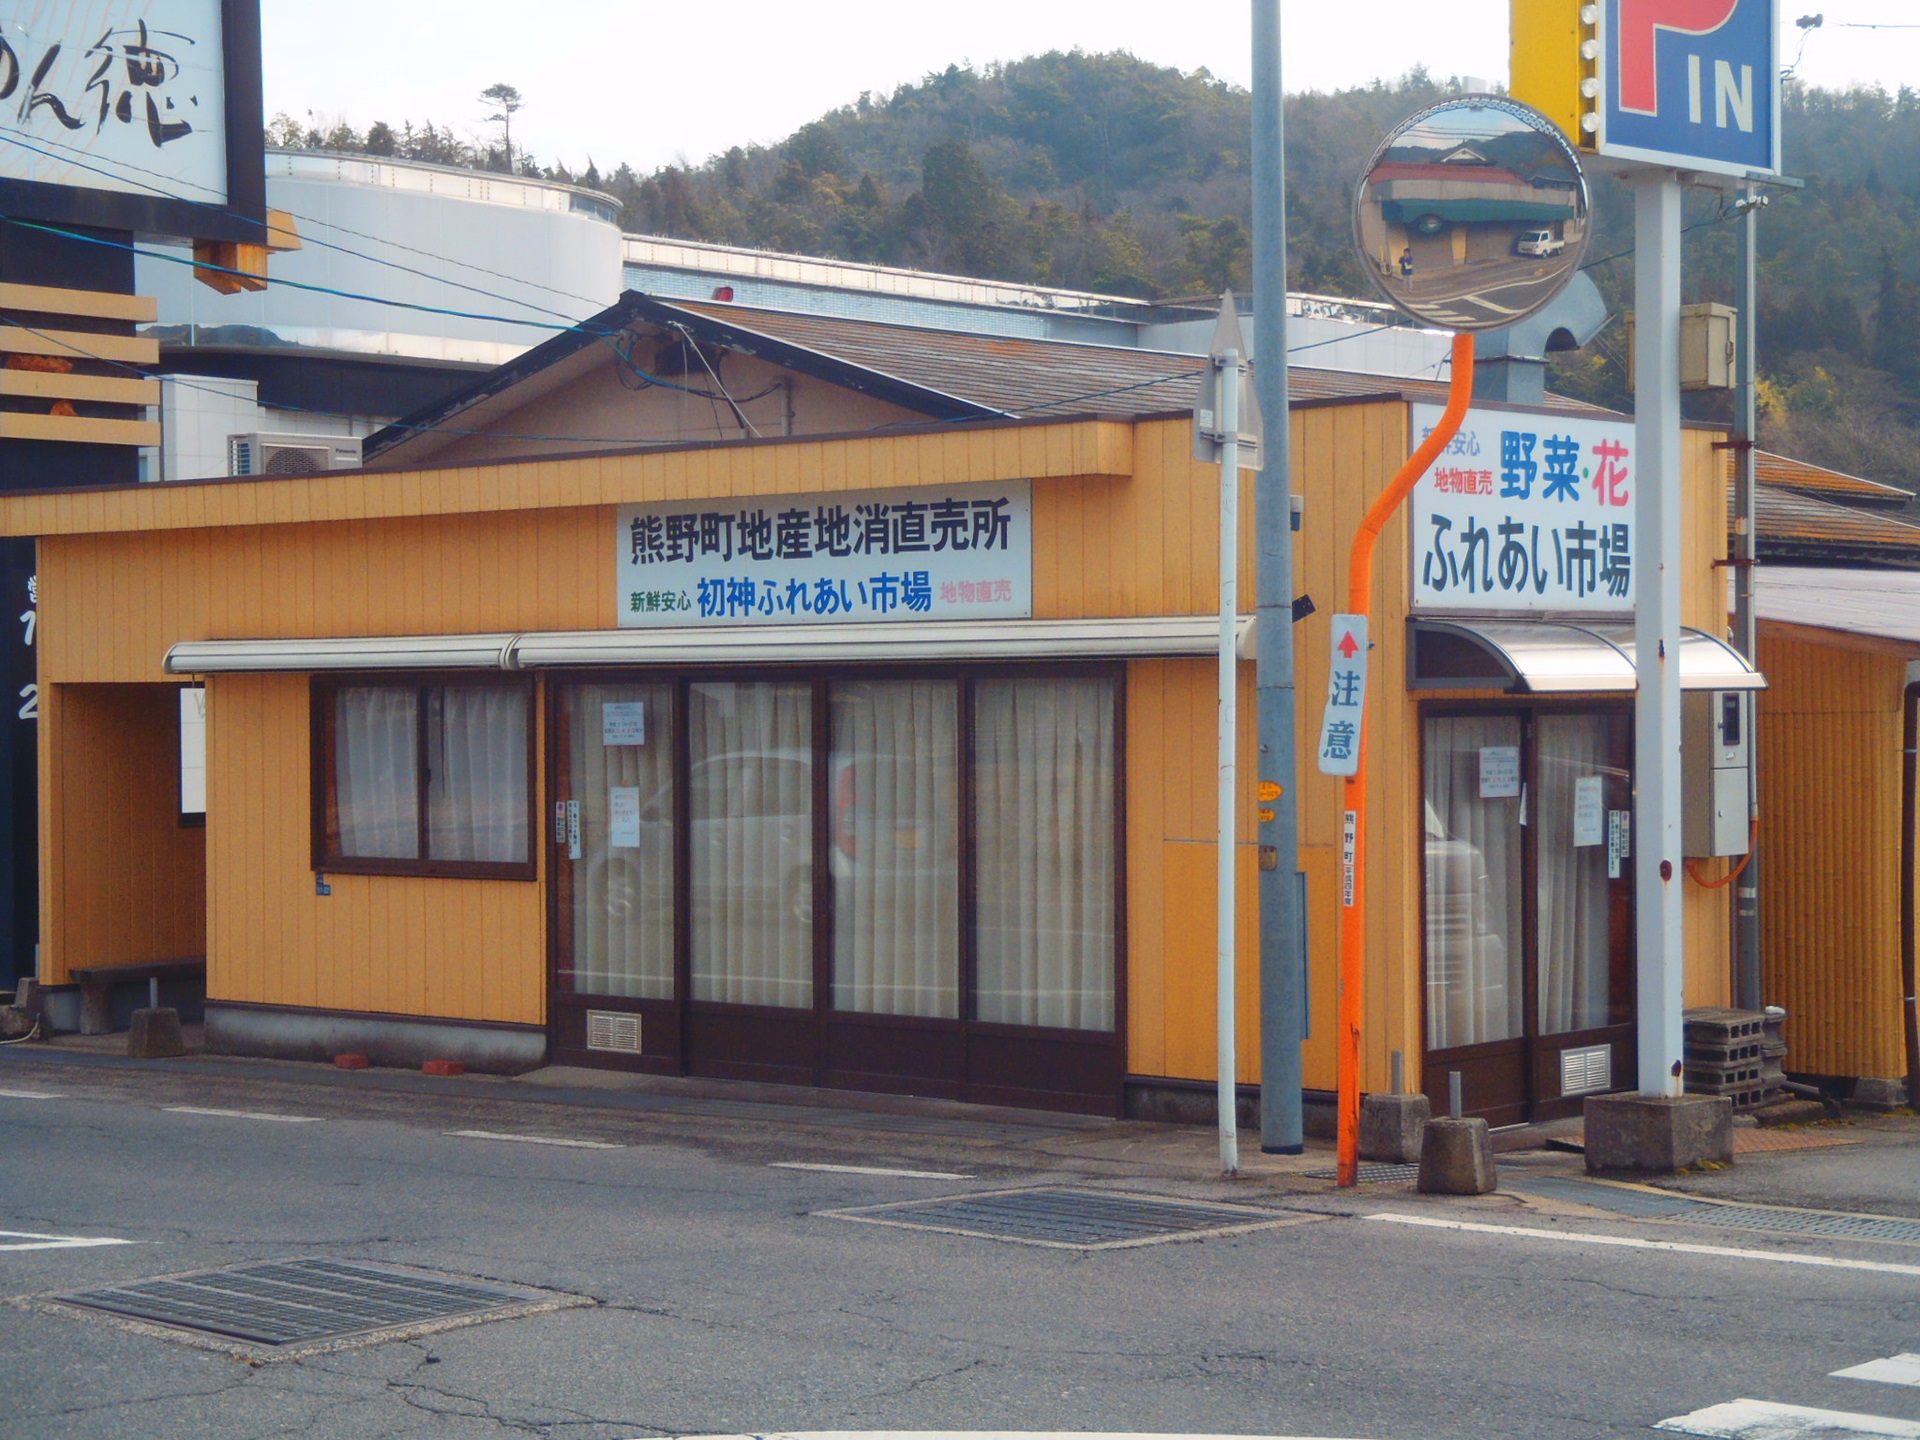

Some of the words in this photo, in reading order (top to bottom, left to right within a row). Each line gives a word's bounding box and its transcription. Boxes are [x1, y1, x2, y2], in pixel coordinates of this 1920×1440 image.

[1687, 53, 1753, 133] IN
[1434, 467, 1493, 495] 地物直売
[630, 497, 1011, 565] 熊野町地産地消直売所
[1423, 513, 1631, 598] ふれあい市場
[630, 590, 691, 613] 新鮮安心
[697, 571, 932, 618] 初神ふれあい市場
[940, 579, 1012, 604] 地物直売
[1323, 670, 1361, 760] 注意
[1344, 813, 1355, 863] 熊野町
